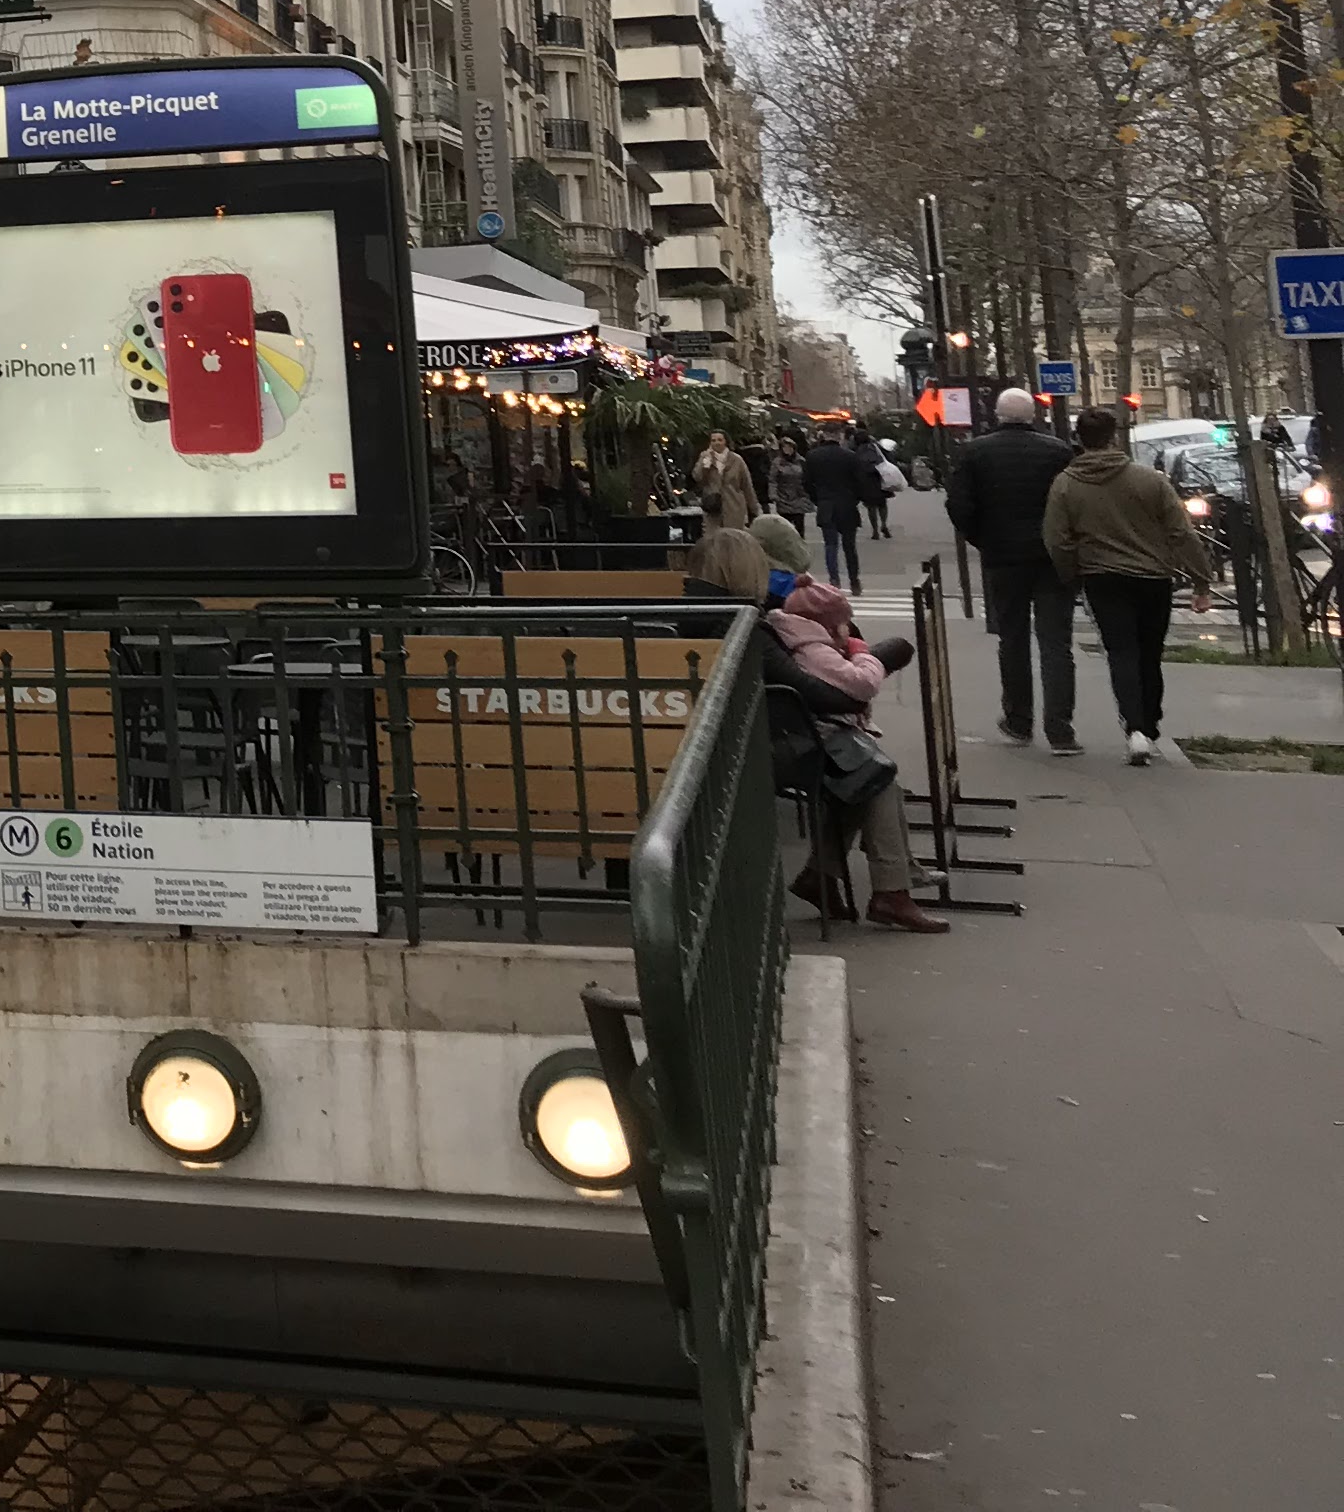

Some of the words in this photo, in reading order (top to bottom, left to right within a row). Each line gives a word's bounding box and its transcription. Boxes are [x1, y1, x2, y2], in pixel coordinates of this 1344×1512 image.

[20, 101, 47, 122] La
[54, 91, 219, 119] Motte-Picquet
[21, 123, 117, 147] Grenelle
[475, 97, 499, 211] HealthCity
[4, 359, 76, 378] iPhone
[78, 357, 96, 376] 11
[435, 686, 688, 718] STARBUCKS
[91, 818, 144, 838] Étoile
[55, 826, 73, 850] 6
[92, 842, 154, 860] Nation
[45, 871, 68, 881] Pour
[70, 872, 95, 883] cette
[97, 872, 124, 885] ligne,
[165, 878, 191, 886] access
[192, 879, 208, 887] this
[262, 881, 276, 889] Per
[46, 882, 79, 892] utiliser
[154, 888, 180, 898] please
[197, 889, 210, 898] the
[212, 891, 248, 899] entrance
[47, 894, 68, 902] sous
[70, 893, 80, 903] le
[155, 897, 179, 906] below
[180, 898, 194, 907] the
[47, 902, 60, 912] 50
[61, 904, 71, 913] m
[73, 904, 112, 915] derrière
[114, 907, 137, 915] vous
[156, 908, 166, 916] 50
[177, 908, 205, 917] behind
